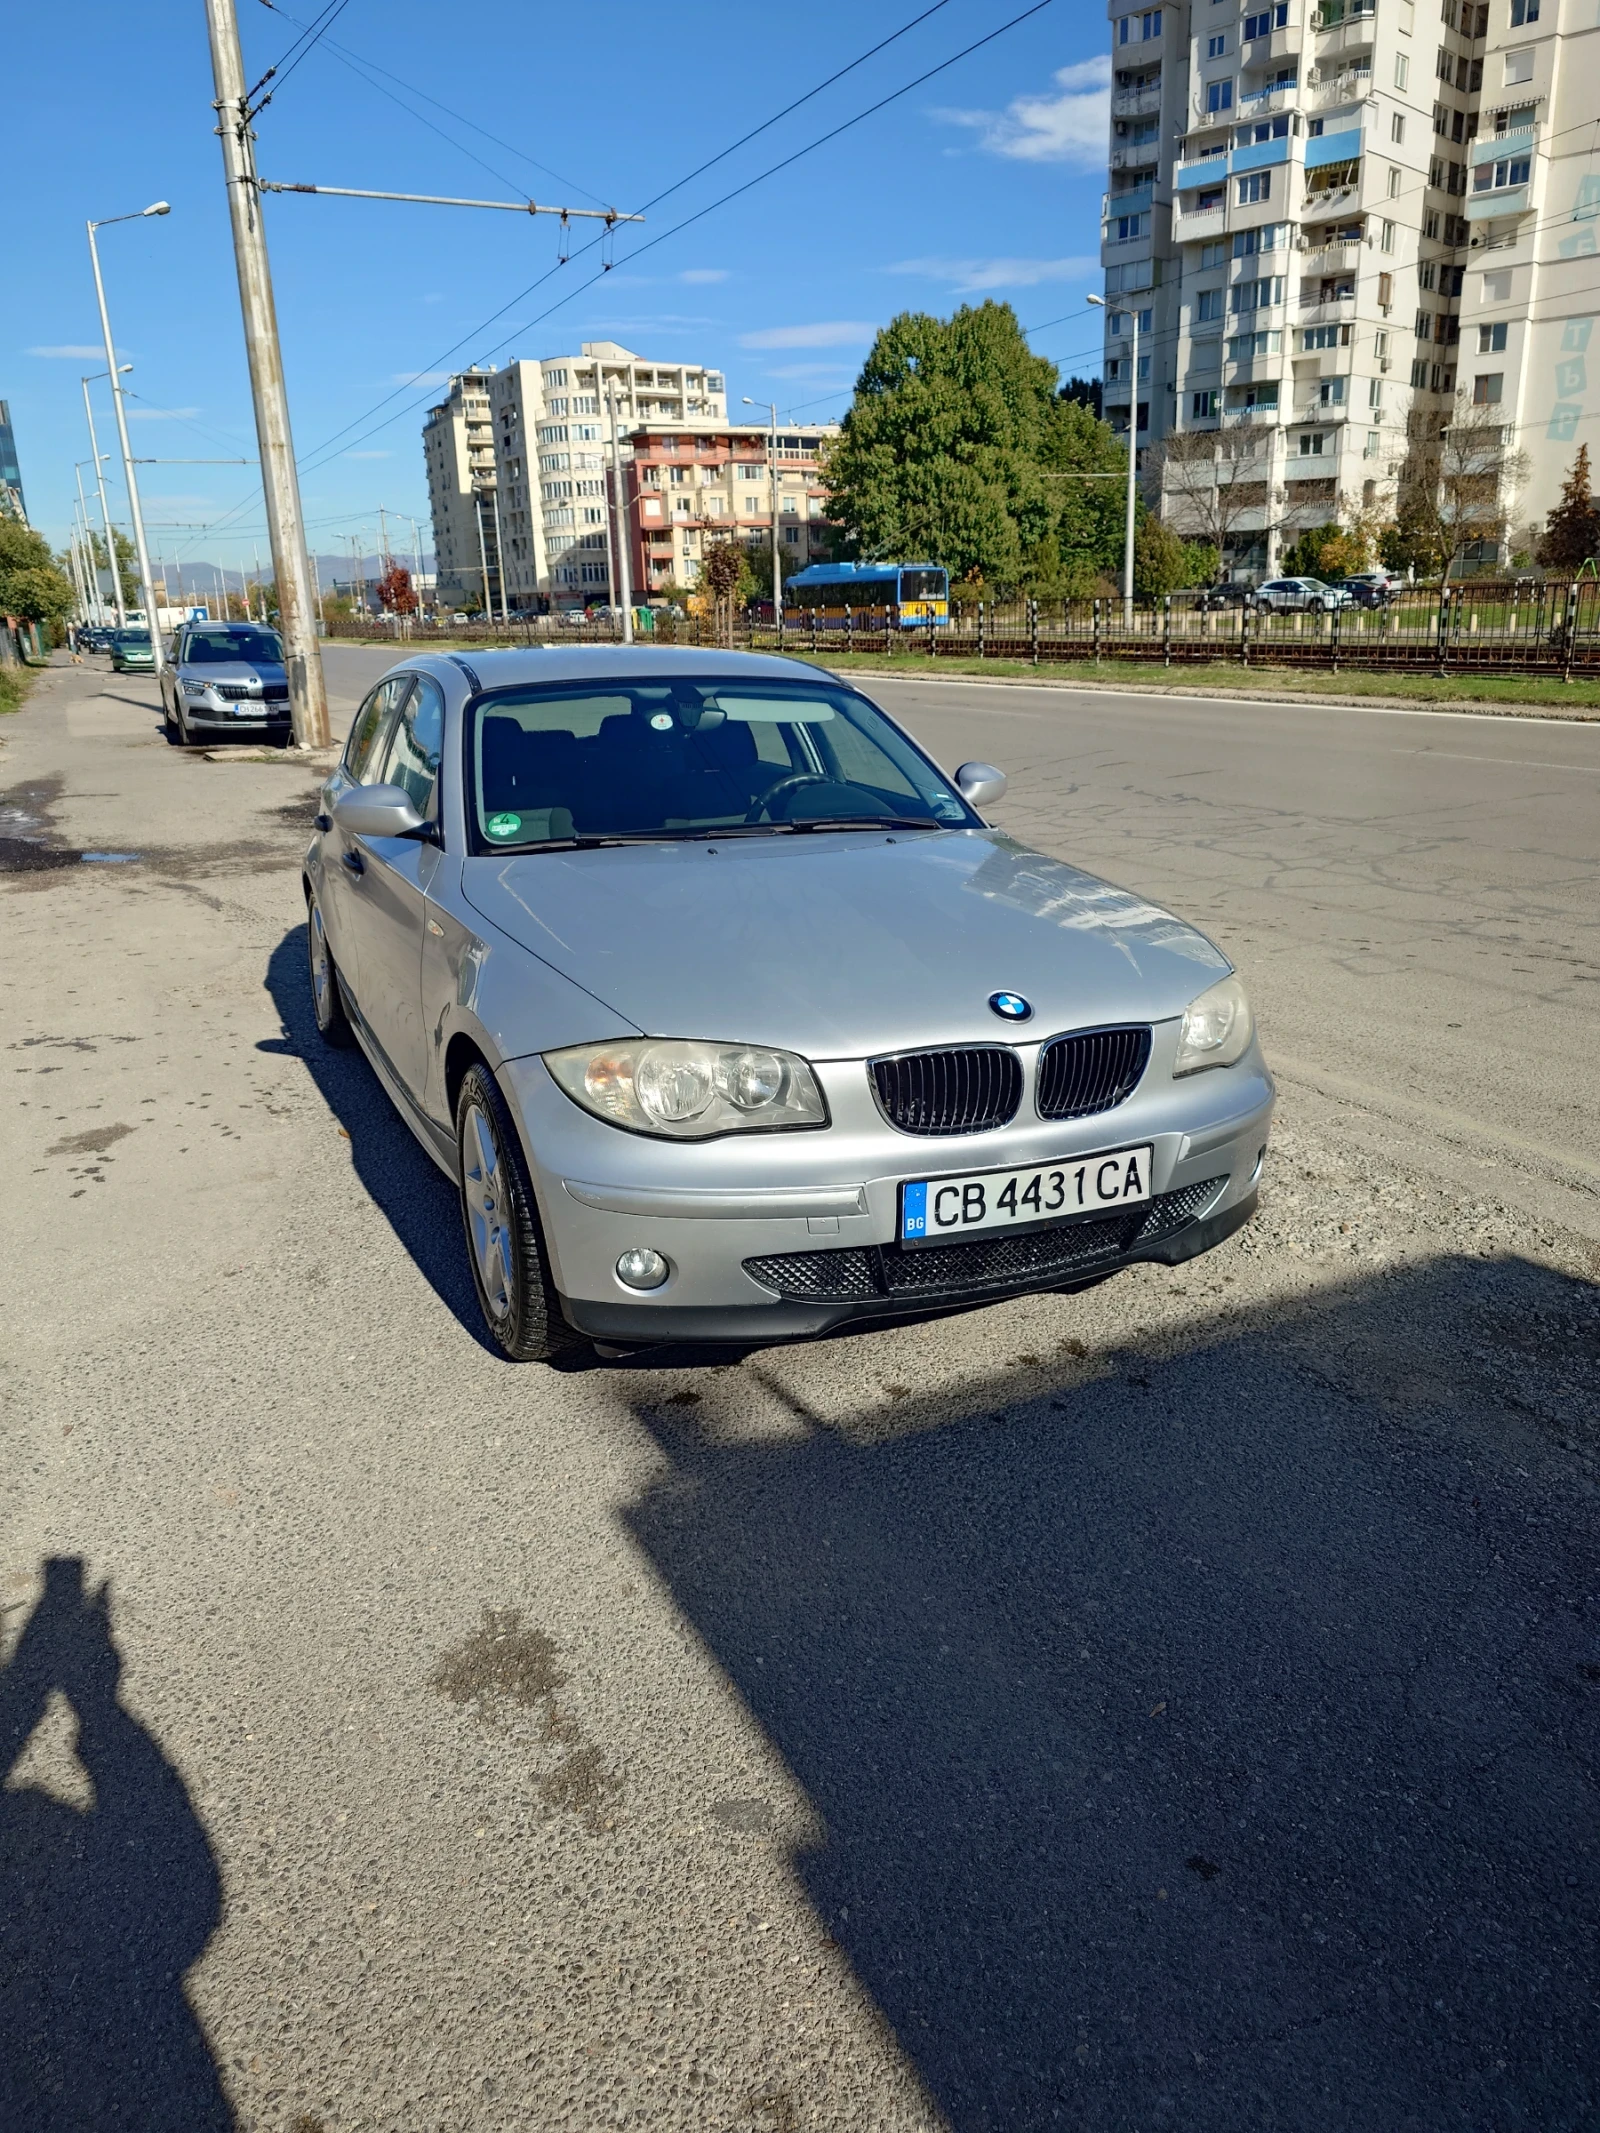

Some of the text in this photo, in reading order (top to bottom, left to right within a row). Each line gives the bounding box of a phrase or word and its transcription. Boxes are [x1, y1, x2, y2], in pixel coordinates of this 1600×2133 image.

[500, 813, 510, 824] 4
[934, 1156, 1143, 1227] CB 4431 CA
[907, 1217, 924, 1231] BG
